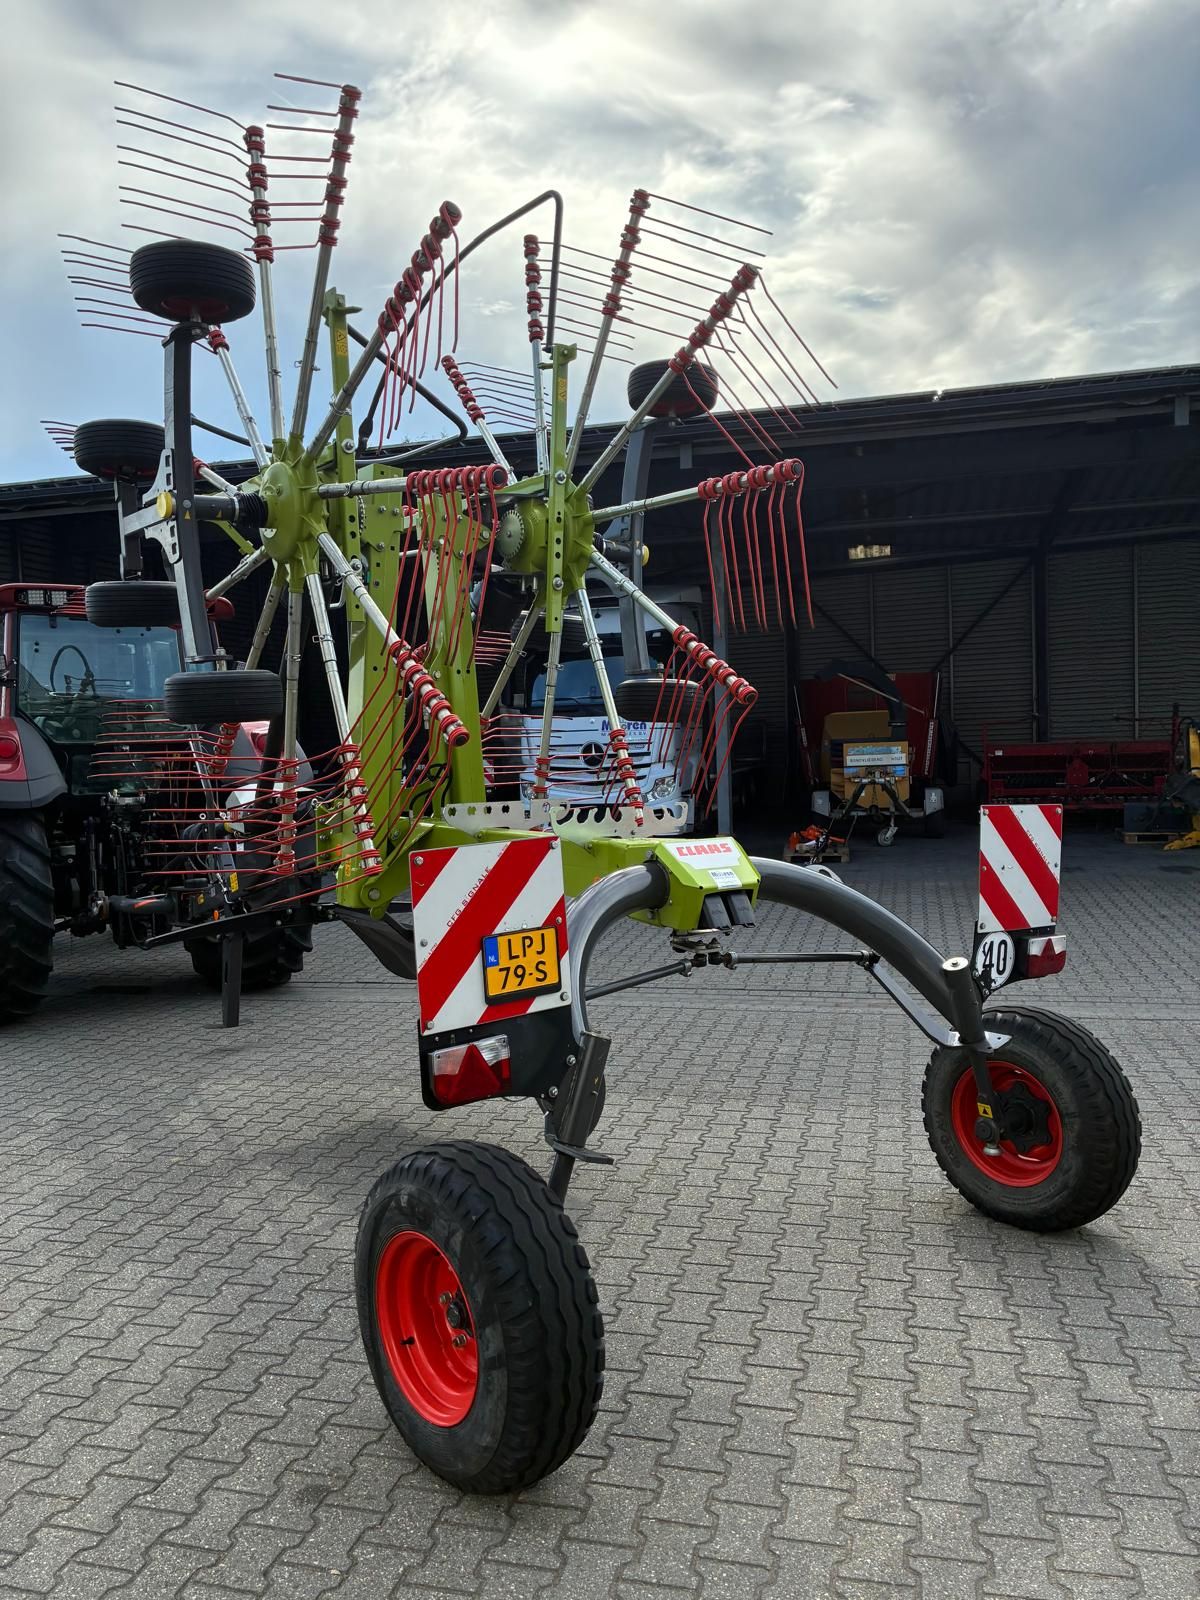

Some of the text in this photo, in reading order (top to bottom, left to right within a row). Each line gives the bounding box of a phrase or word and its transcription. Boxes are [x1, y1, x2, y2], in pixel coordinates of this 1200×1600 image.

[675, 842, 733, 857] CLAAS
[488, 954, 497, 963] NL
[507, 932, 546, 961] LPJ
[982, 939, 1008, 976] 40
[498, 960, 548, 990] 79-S
